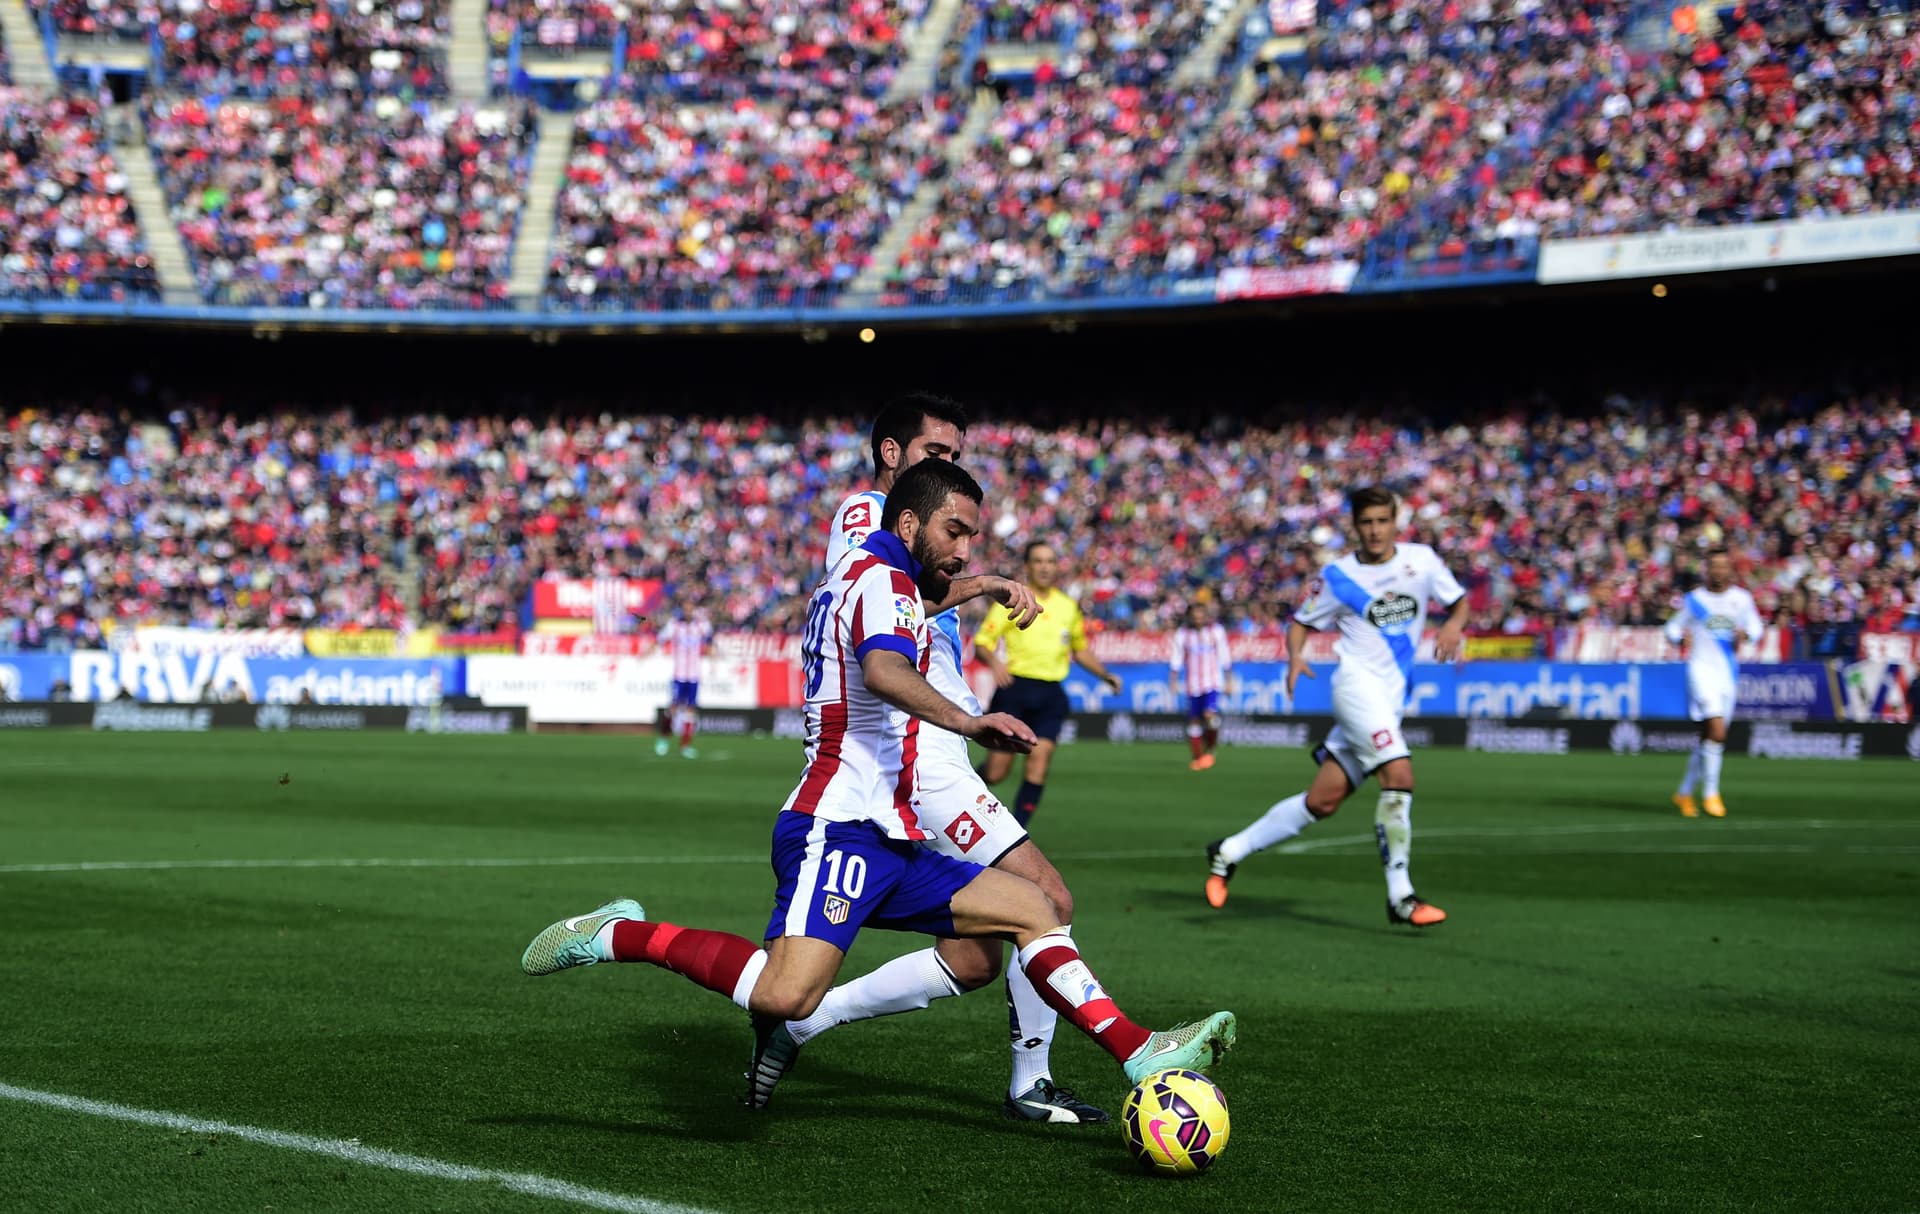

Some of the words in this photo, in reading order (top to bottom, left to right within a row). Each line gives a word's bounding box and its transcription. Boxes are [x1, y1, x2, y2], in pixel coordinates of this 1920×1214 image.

[896, 616, 916, 631] LFP
[70, 649, 256, 704] BBVA
[265, 667, 442, 706] adelante
[1456, 664, 1642, 720] randstad
[822, 849, 866, 899] 10
